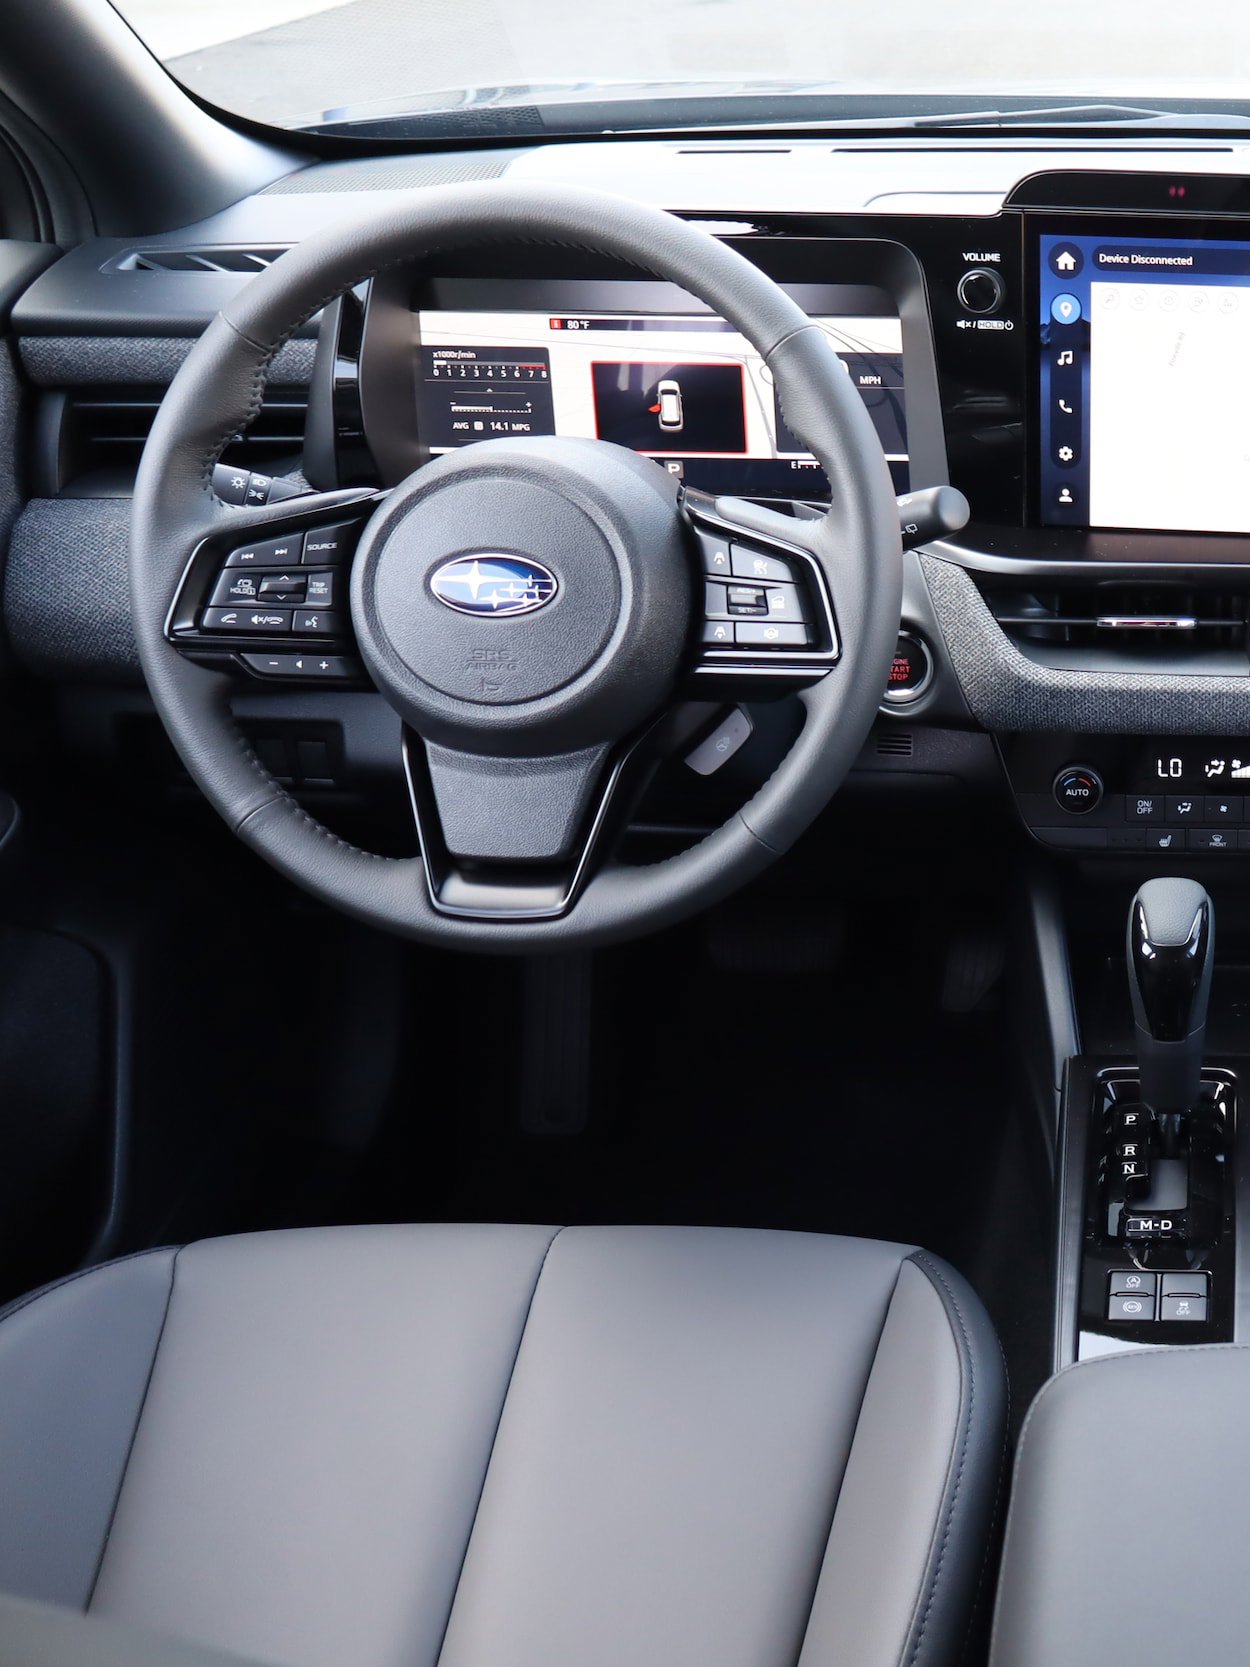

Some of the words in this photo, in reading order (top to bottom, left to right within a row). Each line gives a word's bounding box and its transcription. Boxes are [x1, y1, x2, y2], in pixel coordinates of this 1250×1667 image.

[962, 252, 1000, 262] VOLUME
[1099, 253, 1130, 264] Device
[1130, 254, 1192, 266] Disconnected
[568, 320, 579, 330] 80
[978, 321, 1003, 329] HOLD
[432, 350, 476, 359] x1000r/min
[433, 368, 440, 377] 0
[447, 368, 452, 377] 1
[460, 368, 466, 377] 2
[474, 368, 480, 377] 3
[486, 368, 494, 377] 4
[501, 368, 507, 378] 5
[514, 368, 520, 378] 6
[528, 368, 534, 378] 7
[542, 369, 547, 378] 8
[860, 376, 882, 385] MPH
[490, 422, 509, 430] 14.1
[512, 424, 530, 432] MPG
[668, 464, 680, 474] P
[791, 461, 797, 469] E
[306, 542, 338, 551] SOURCE
[472, 649, 512, 660] SRS
[1158, 758, 1182, 778] LO
[1126, 1116, 1136, 1124] P
[1126, 1146, 1136, 1155] R
[1124, 1164, 1134, 1174] N
